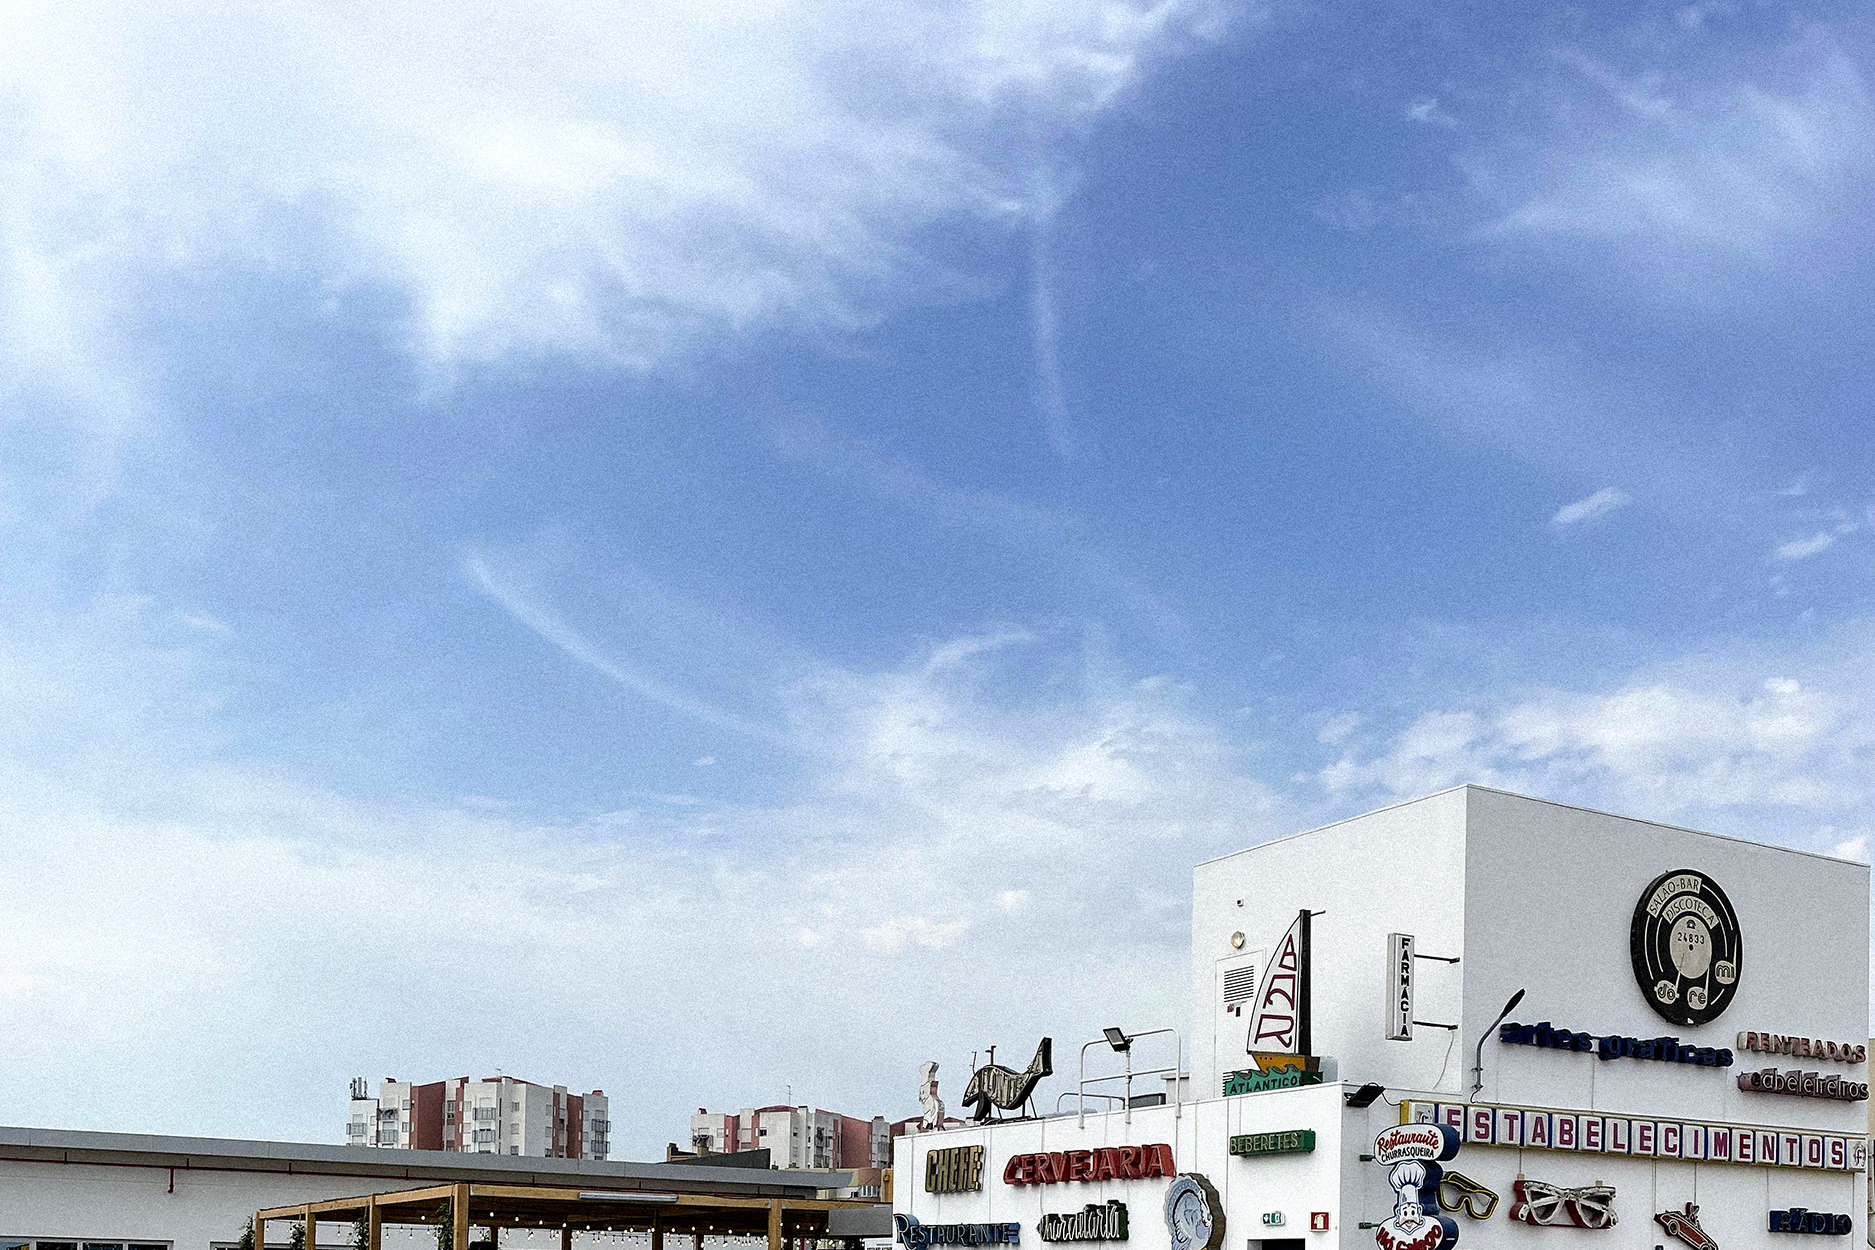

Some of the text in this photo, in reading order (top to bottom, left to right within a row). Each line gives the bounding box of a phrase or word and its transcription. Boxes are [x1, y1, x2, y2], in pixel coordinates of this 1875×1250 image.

[1649, 877, 1700, 915] SALÃO-BAR
[1665, 898, 1716, 926] DISCOTECA
[1677, 931, 1705, 945] 24833
[1745, 1031, 1867, 1064] PENTEADOS
[1229, 1131, 1300, 1156] BEBERETES
[1446, 1108, 1844, 1166] ESTABELECIMENTOS
[925, 1145, 984, 1193] CHEFE
[1004, 1143, 1176, 1186] CERVEJARIA
[1381, 1146, 1435, 1163] CHURRASQUEIRA
